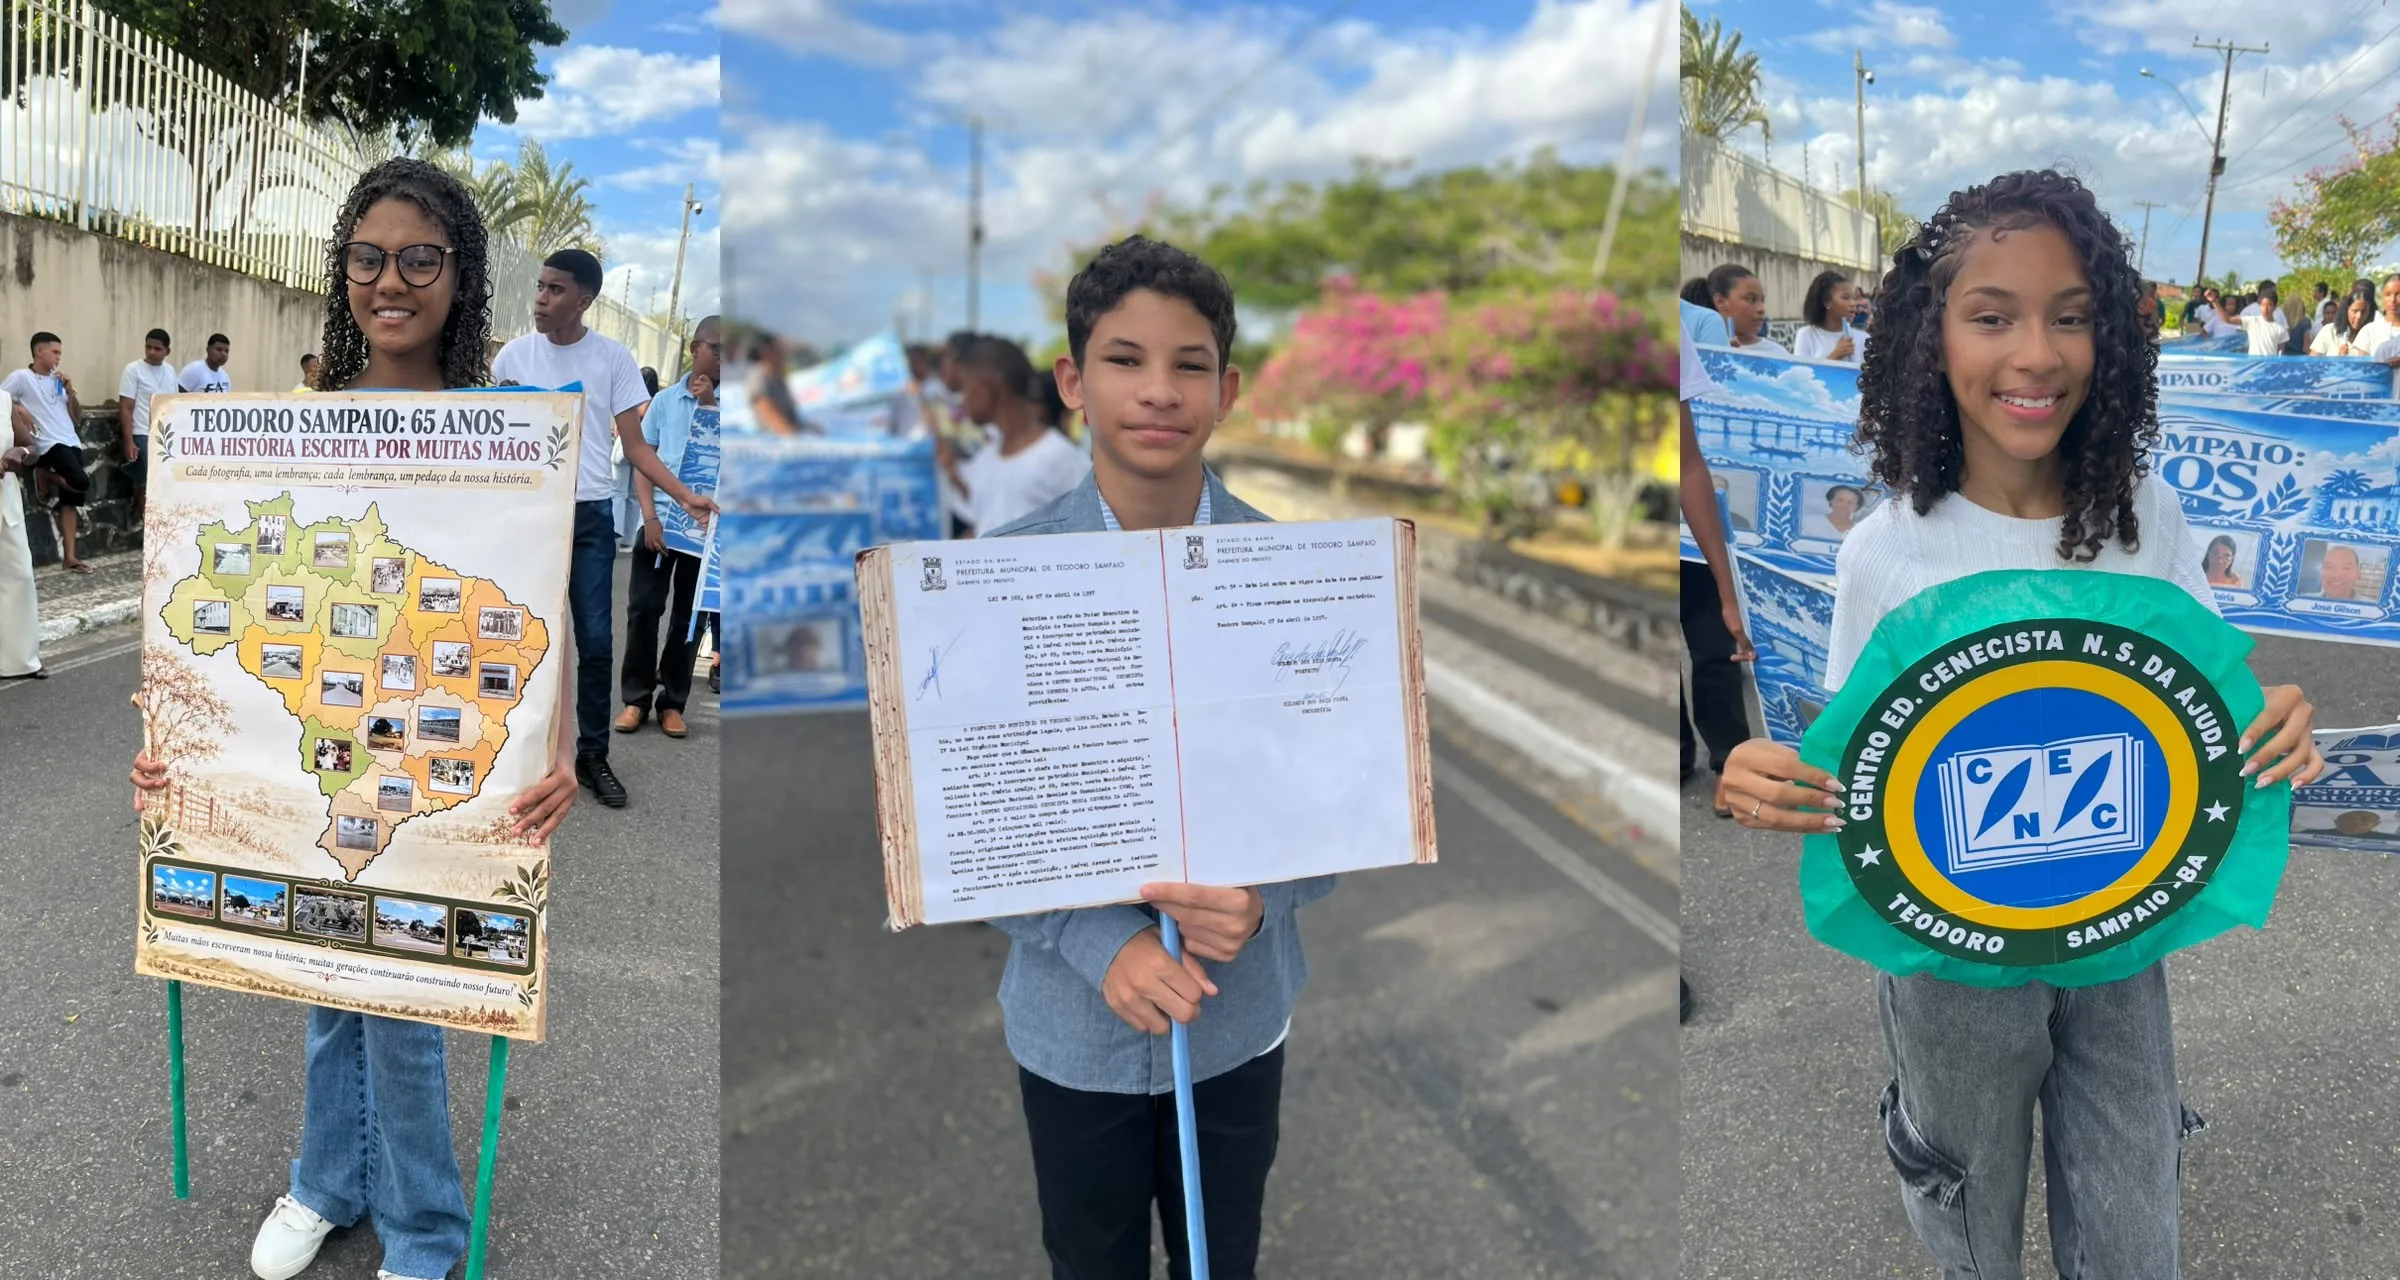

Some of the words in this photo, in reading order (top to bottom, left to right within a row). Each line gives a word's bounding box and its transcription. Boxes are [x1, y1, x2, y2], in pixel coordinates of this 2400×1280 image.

[191, 408, 294, 433] TEODORO
[299, 408, 406, 434] SAMPAIO:
[411, 408, 436, 435] 65
[440, 408, 505, 435] ANOS
[181, 437, 215, 456] UMA
[220, 433, 296, 457] HISTÓRIA
[301, 438, 370, 458] ESCRITA
[375, 439, 411, 459] POR
[416, 439, 482, 460] MUITAS
[487, 437, 541, 461] MÃOS
[2163, 433, 2306, 467] MPAIO:
[185, 465, 208, 477] Cada
[208, 466, 252, 480] fotografia,
[254, 470, 273, 479] uma
[274, 467, 321, 482] lembrança;
[323, 468, 344, 480] cada
[348, 469, 397, 484] lembrança,
[399, 473, 414, 482] um
[413, 470, 447, 485] pedaço
[449, 471, 461, 483] da
[463, 474, 490, 484] nossa
[492, 472, 533, 485] história.
[2151, 452, 2258, 501] OS
[1258, 544, 1293, 552] MUNICIPAL
[1311, 541, 1343, 549] TEODORO
[1000, 566, 1037, 574] MUNICIPAL
[1056, 563, 1090, 571] TEODORO
[1094, 561, 1125, 569] SAMPAIO
[2312, 602, 2332, 611] José
[2334, 605, 2361, 615] Gilson
[1850, 731, 1891, 821] CENTRO
[1880, 696, 1923, 729] ED.
[1919, 630, 2064, 693] CENECISTA
[2082, 632, 2109, 657] N.
[2115, 642, 2136, 667] S.
[2141, 655, 2177, 689] DA
[2174, 686, 2228, 762] AJUDA
[1966, 758, 1993, 785] C
[2048, 748, 2072, 776] E
[2013, 812, 2040, 840] N
[2090, 803, 2118, 830] C
[1887, 892, 2005, 954] TEODORO
[2066, 890, 2170, 948] SAMPAIO
[191, 935, 210, 947] mãos
[211, 941, 251, 955] escreveram
[253, 949, 273, 959] nossa
[274, 949, 307, 965] história;
[309, 957, 334, 969] muitas
[336, 963, 368, 976] gerações
[370, 969, 415, 982] continuarão
[415, 975, 461, 989] construindo
[463, 983, 484, 992] nosso
